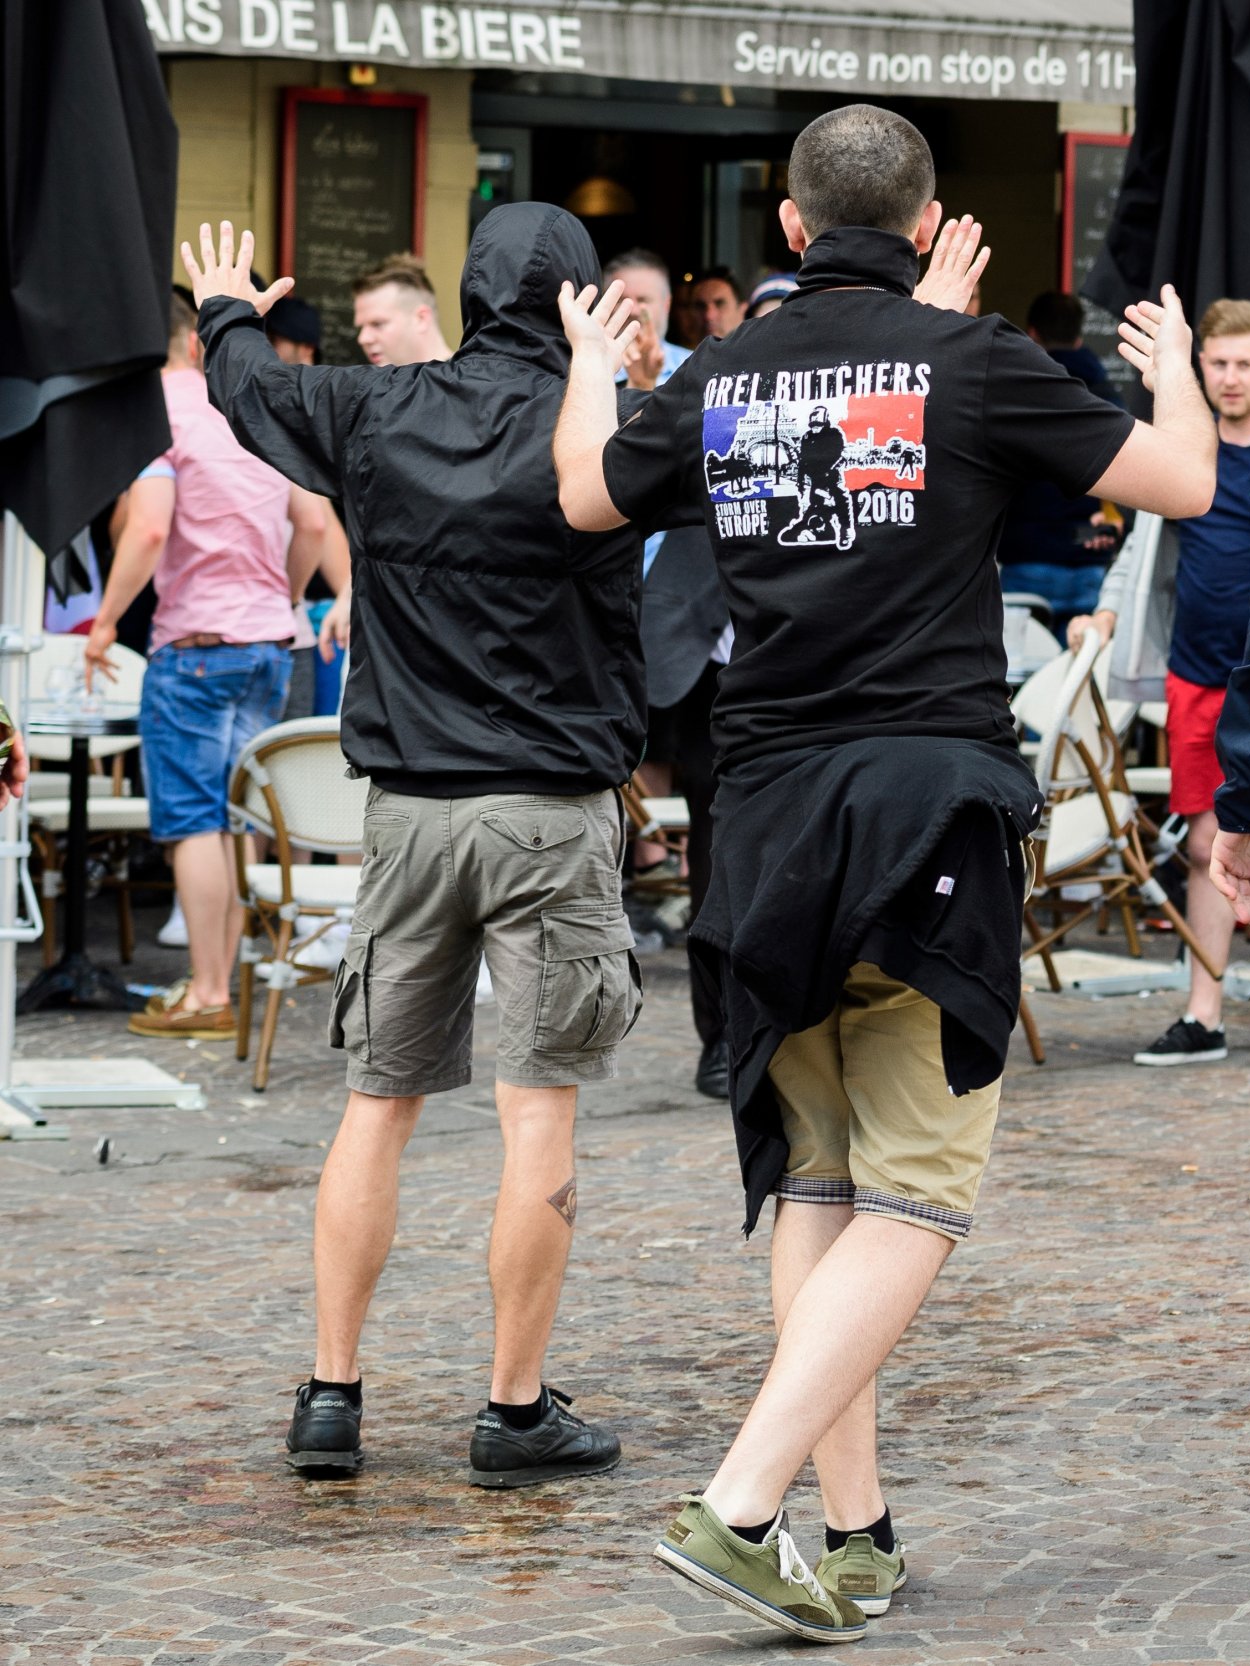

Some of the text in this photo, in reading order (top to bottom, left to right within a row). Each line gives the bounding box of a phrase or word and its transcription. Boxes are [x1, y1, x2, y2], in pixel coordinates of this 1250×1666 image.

[240, 0, 318, 51] DE
[333, 2, 409, 57] LA
[421, 5, 585, 68] BIERE
[734, 31, 1137, 96] Service non stop de 11H
[703, 362, 931, 410] OREL BUTCHERS
[715, 499, 767, 517] STORM OVER
[717, 513, 769, 540] EUROPE
[857, 491, 915, 524] 2016
